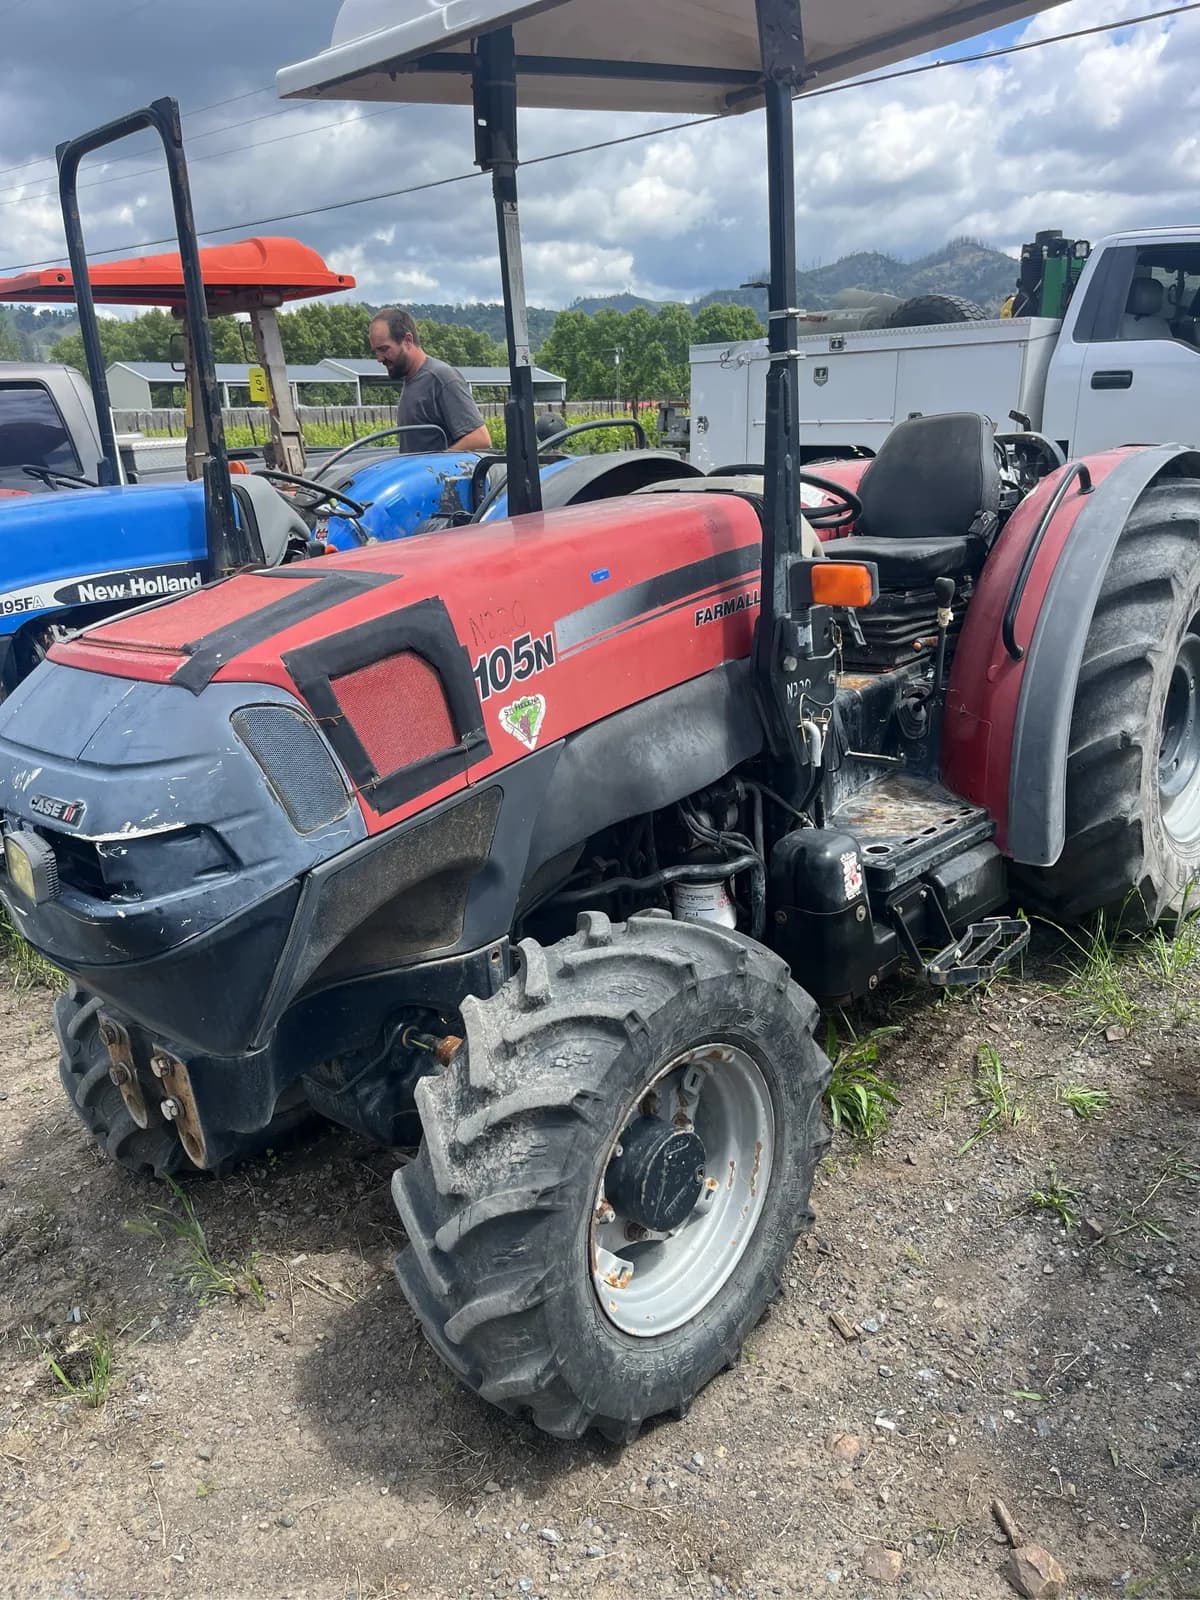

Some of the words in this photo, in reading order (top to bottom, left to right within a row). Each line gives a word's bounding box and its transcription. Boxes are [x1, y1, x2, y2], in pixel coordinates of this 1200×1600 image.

[77, 583, 124, 603] New
[129, 573, 202, 597] Holland
[695, 589, 762, 628] FARMALL
[473, 631, 556, 702] 105N
[31, 796, 63, 818] CASE
